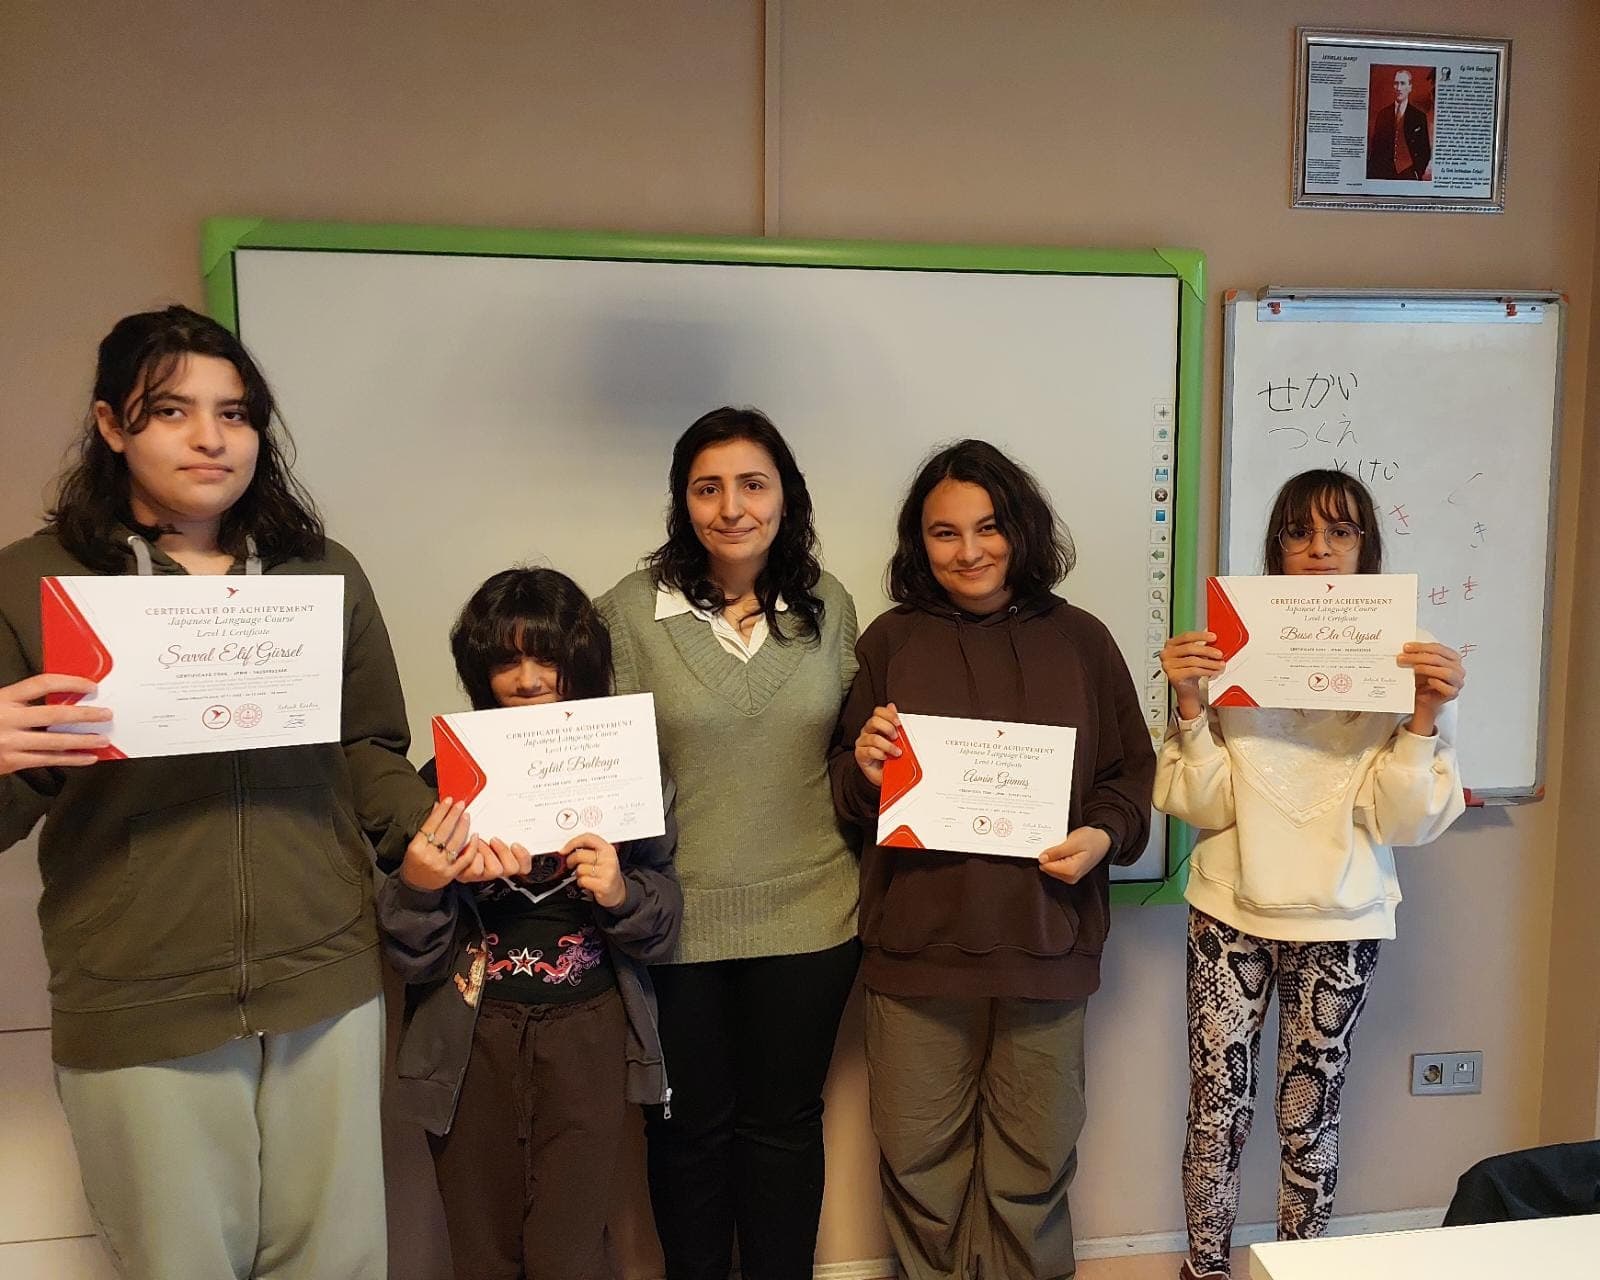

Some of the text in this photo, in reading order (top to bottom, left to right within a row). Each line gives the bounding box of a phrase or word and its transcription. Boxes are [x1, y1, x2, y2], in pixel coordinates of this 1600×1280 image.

[1257, 372, 1358, 412] せかい
[1268, 413, 1359, 450] つくえ
[1270, 598, 1394, 606] CERTIFICATE OF ACHIEVEMENT
[144, 604, 316, 617] CERTIFICATE OF ACHIEVEMENT
[1286, 605, 1379, 615] Japanese Language Course
[167, 613, 296, 628] Japanese Language Course
[229, 628, 271, 638] Certificate
[1279, 625, 1383, 645] Buse Ela Uysal
[218, 642, 254, 667] Elif
[254, 641, 305, 666] Gürsel
[945, 739, 991, 749] CERTIFICATE
[1003, 744, 1055, 755] ACHIEVEMENT
